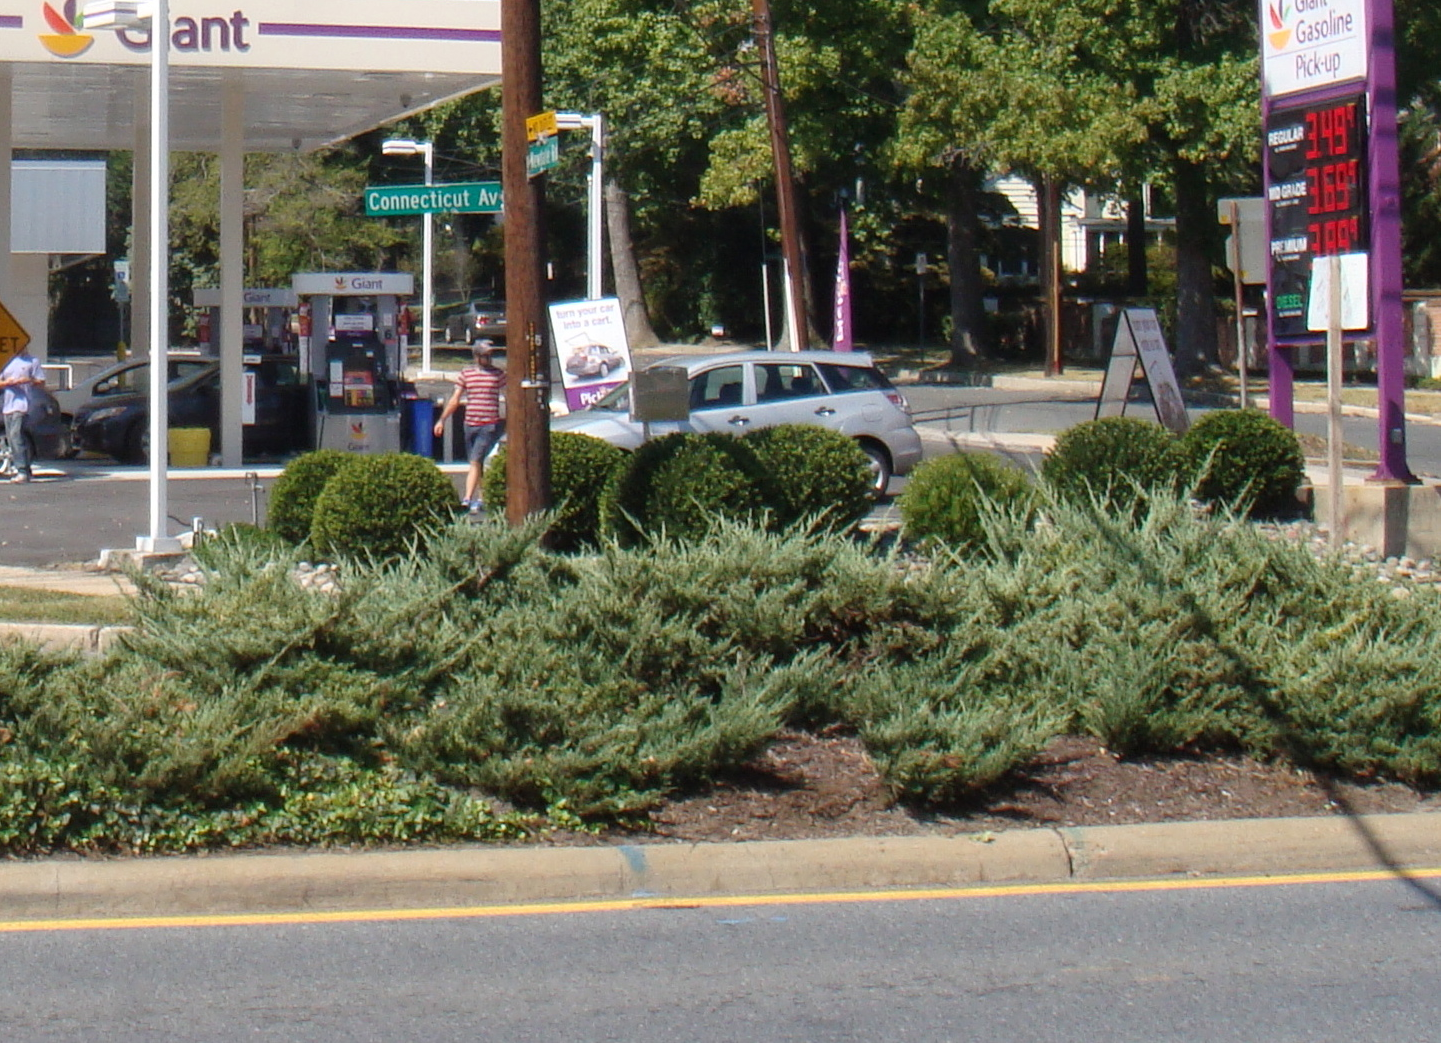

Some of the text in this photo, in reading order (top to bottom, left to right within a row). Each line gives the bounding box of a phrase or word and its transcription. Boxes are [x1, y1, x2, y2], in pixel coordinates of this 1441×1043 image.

[1296, 9, 1353, 44] Gasoline
[1296, 51, 1341, 79] Pick-up
[1268, 126, 1304, 147] REGULAR
[1281, 180, 1307, 198] GRADE
[369, 189, 470, 211] Connecticut
[1271, 237, 1307, 256] PREMIUM
[351, 278, 383, 290] Giant
[244, 291, 271, 303] Giant
[556, 304, 615, 319] turn your car
[563, 319, 581, 330] into
[584, 319, 590, 327] a
